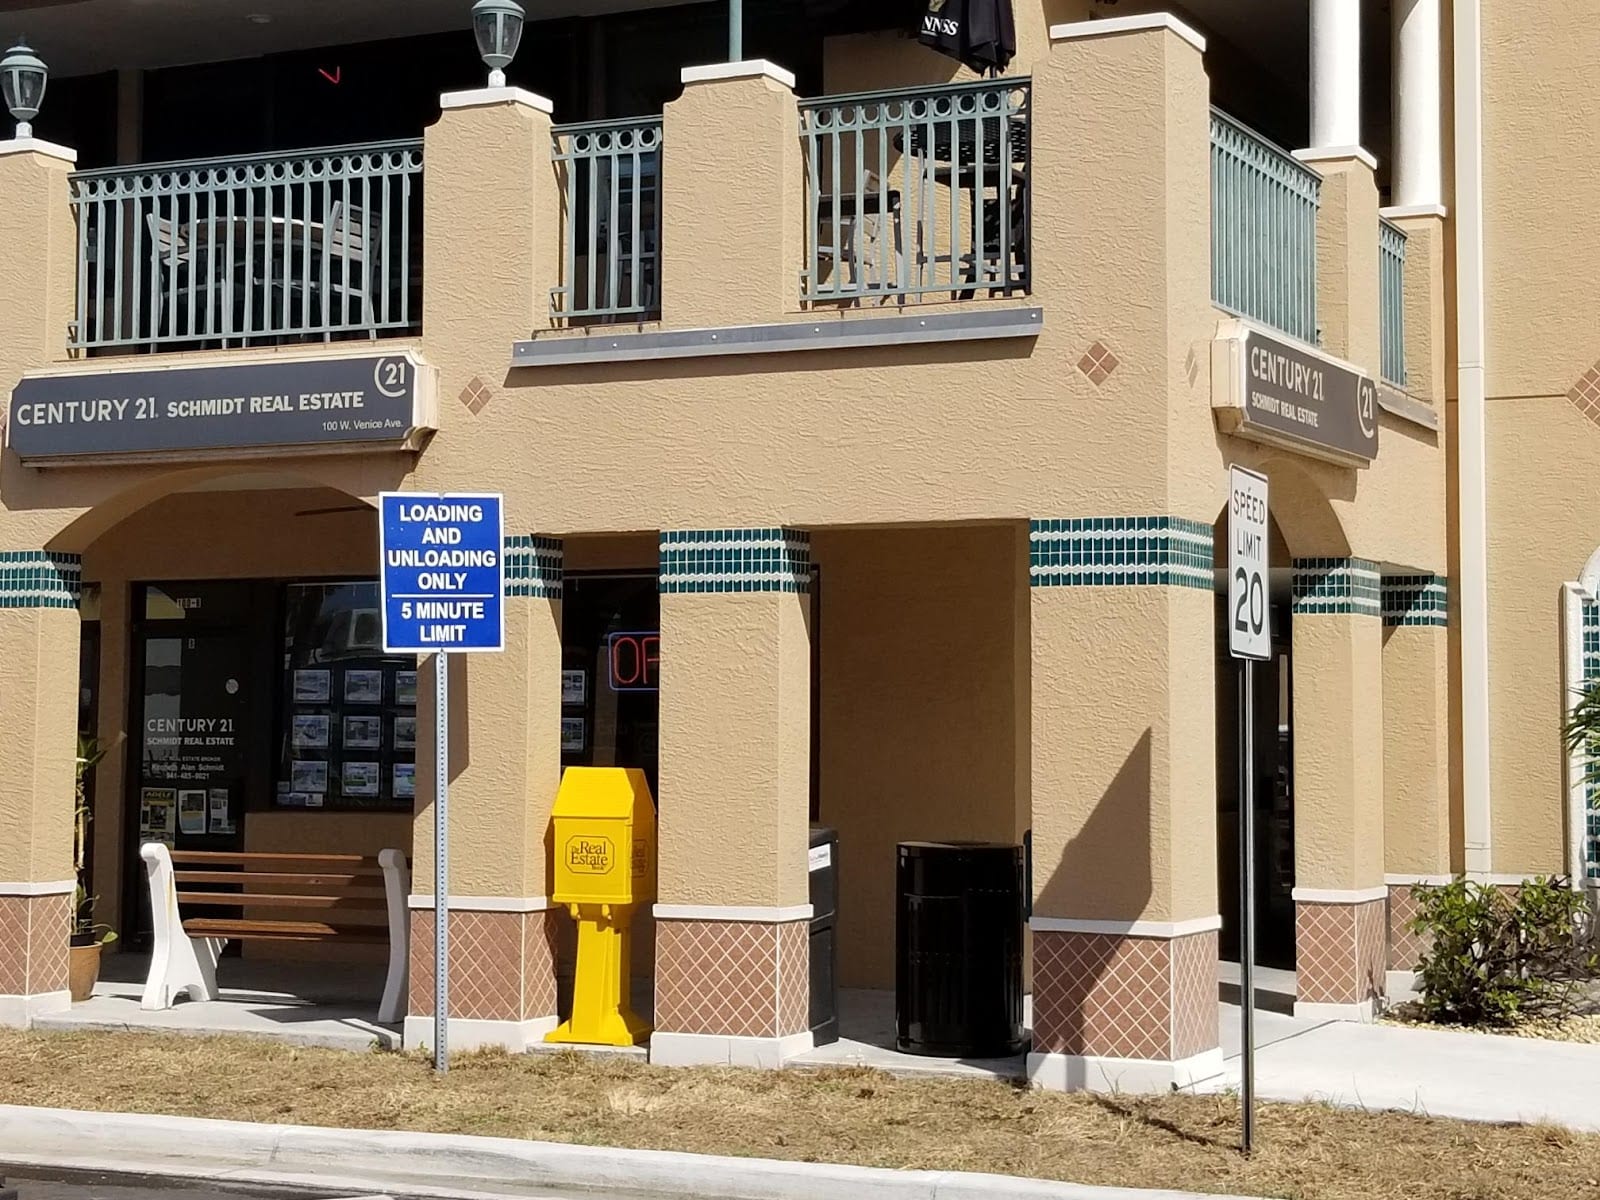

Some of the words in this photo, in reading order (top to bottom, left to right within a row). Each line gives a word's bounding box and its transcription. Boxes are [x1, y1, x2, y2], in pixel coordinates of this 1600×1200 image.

[1251, 346, 1311, 395] CENTURY
[17, 398, 129, 426] CENTURY
[167, 398, 245, 418] SCHMIDT
[250, 395, 293, 414] REAL
[299, 391, 364, 410] ESTATE
[1252, 391, 1280, 415] SCHMIDT
[1281, 401, 1296, 420] REAL
[1298, 408, 1319, 427] ESTATE
[322, 421, 338, 431] 100
[340, 420, 351, 430] W.
[354, 419, 382, 429] Venice
[384, 419, 403, 428] Ave.
[400, 504, 483, 522] LOADING
[1233, 489, 1265, 526] SPEED
[422, 527, 461, 544] AND
[1237, 528, 1262, 562] LIMIT
[388, 550, 497, 567] UNLOADING
[418, 572, 467, 590] ONLY
[1235, 566, 1263, 636] 20
[401, 602, 412, 620] 5
[416, 602, 484, 619] MINUTE
[420, 624, 466, 642] LIMIT
[147, 719, 216, 732] CENTURY
[147, 737, 182, 745] SCHMIDT
[184, 737, 204, 745] REAL
[205, 737, 235, 745] ESTATE
[581, 841, 606, 855] Real
[571, 852, 608, 866] Estate
